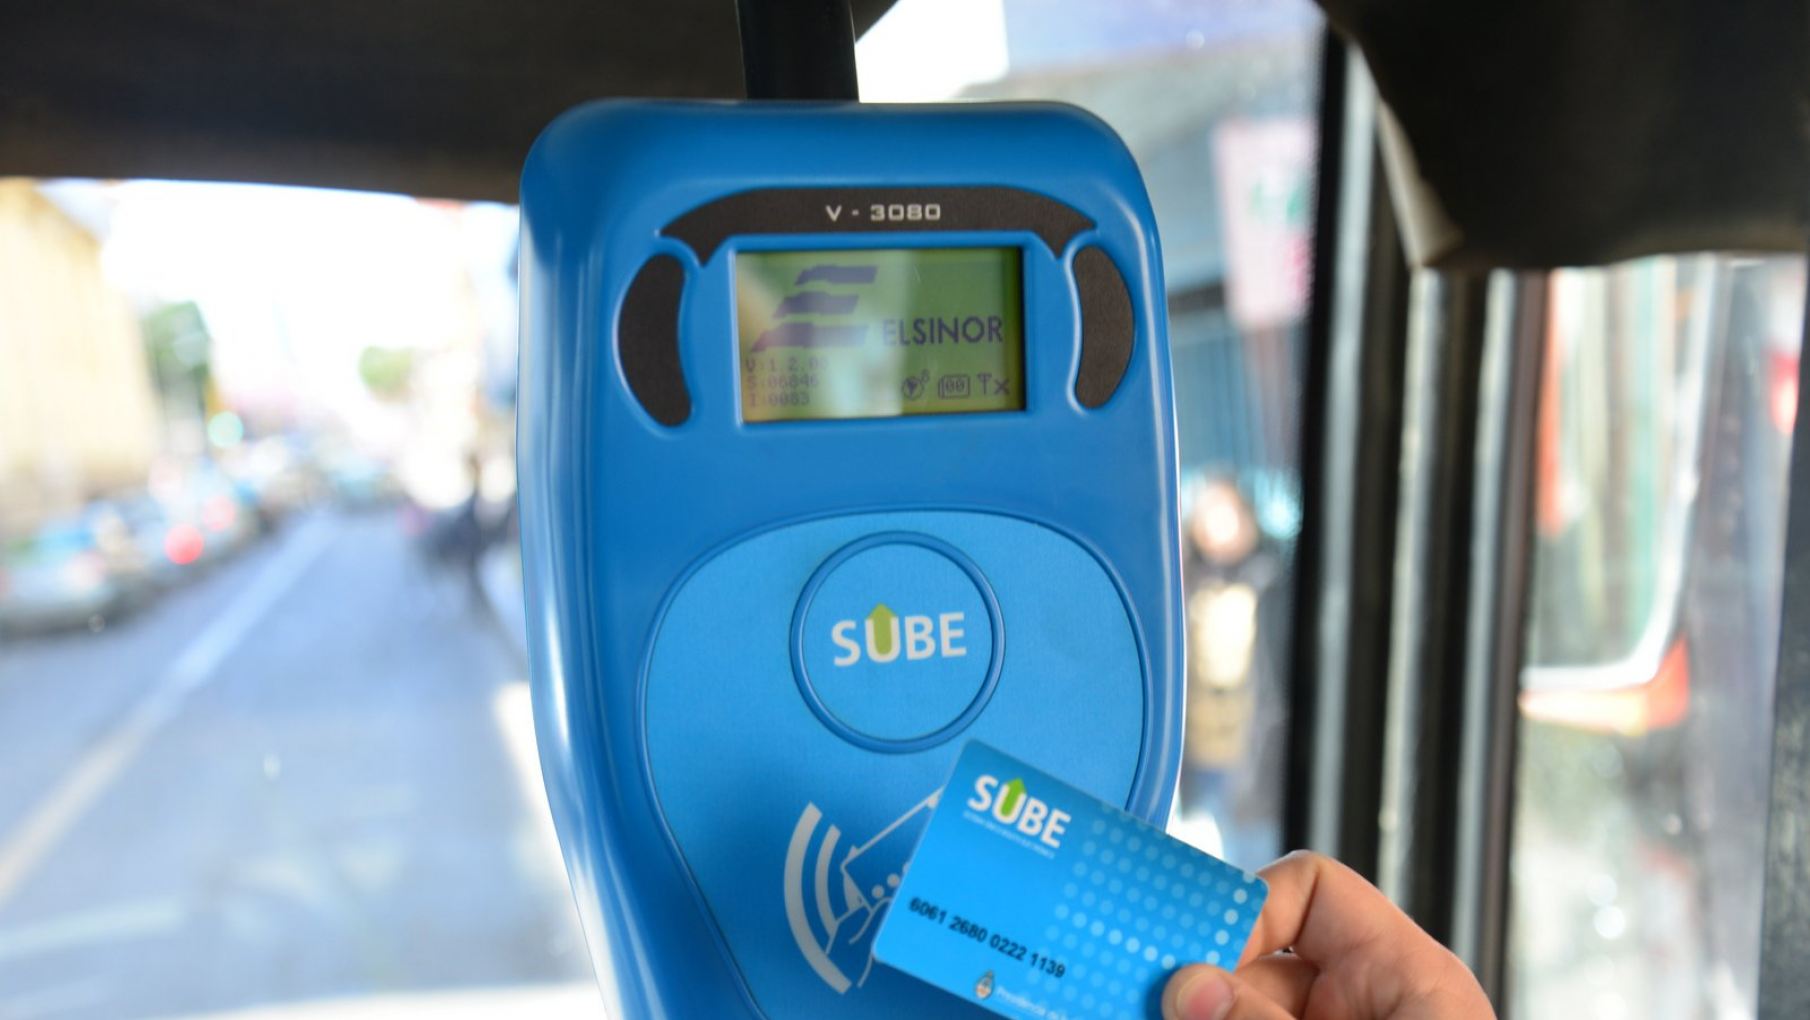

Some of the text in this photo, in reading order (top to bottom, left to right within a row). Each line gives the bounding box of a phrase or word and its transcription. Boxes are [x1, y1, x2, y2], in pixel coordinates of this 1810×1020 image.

[825, 205, 842, 222] V
[870, 204, 941, 221] 3080
[883, 316, 1003, 345] ELSINOR
[831, 609, 967, 667] SUBE
[967, 774, 1072, 849] SUBE
[909, 896, 1066, 979] 6061 2680 0222 1139
